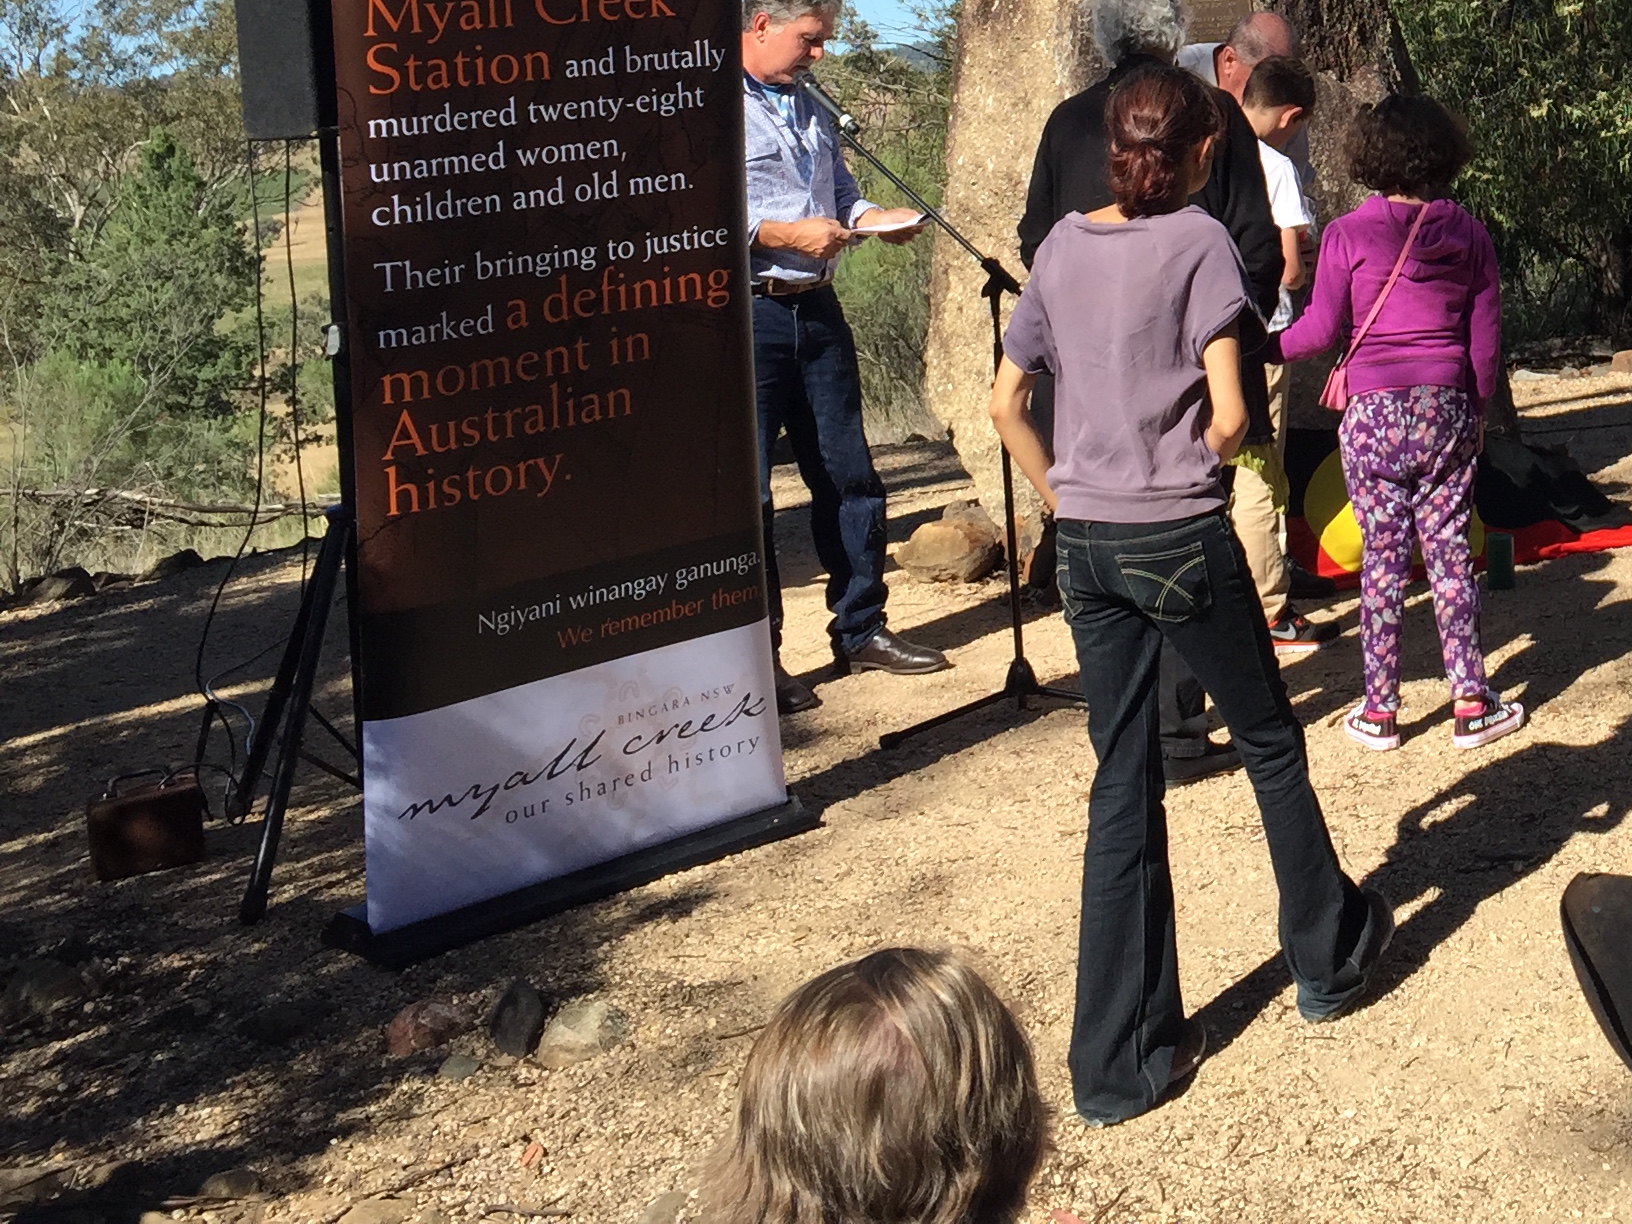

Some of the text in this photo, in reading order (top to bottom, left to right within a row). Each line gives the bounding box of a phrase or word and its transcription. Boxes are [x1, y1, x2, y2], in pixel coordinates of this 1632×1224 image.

[365, 40, 726, 94] Station and brutally
[368, 82, 705, 139] murdered twenty-eight
[369, 137, 627, 182] unarmed women,
[372, 171, 693, 226] children and old men.
[374, 225, 728, 293] Their bringing to justice
[378, 266, 731, 348] marked a defining
[381, 326, 651, 405] moment in
[382, 382, 633, 461] Australian
[386, 454, 571, 517] history.
[478, 550, 761, 635] Ngiyani winangay ganunga.
[557, 625, 593, 648] We
[600, 597, 704, 638] remember
[617, 683, 736, 724] BINGARA NSW
[399, 692, 767, 820] myall creek
[506, 735, 760, 823] our shared history
